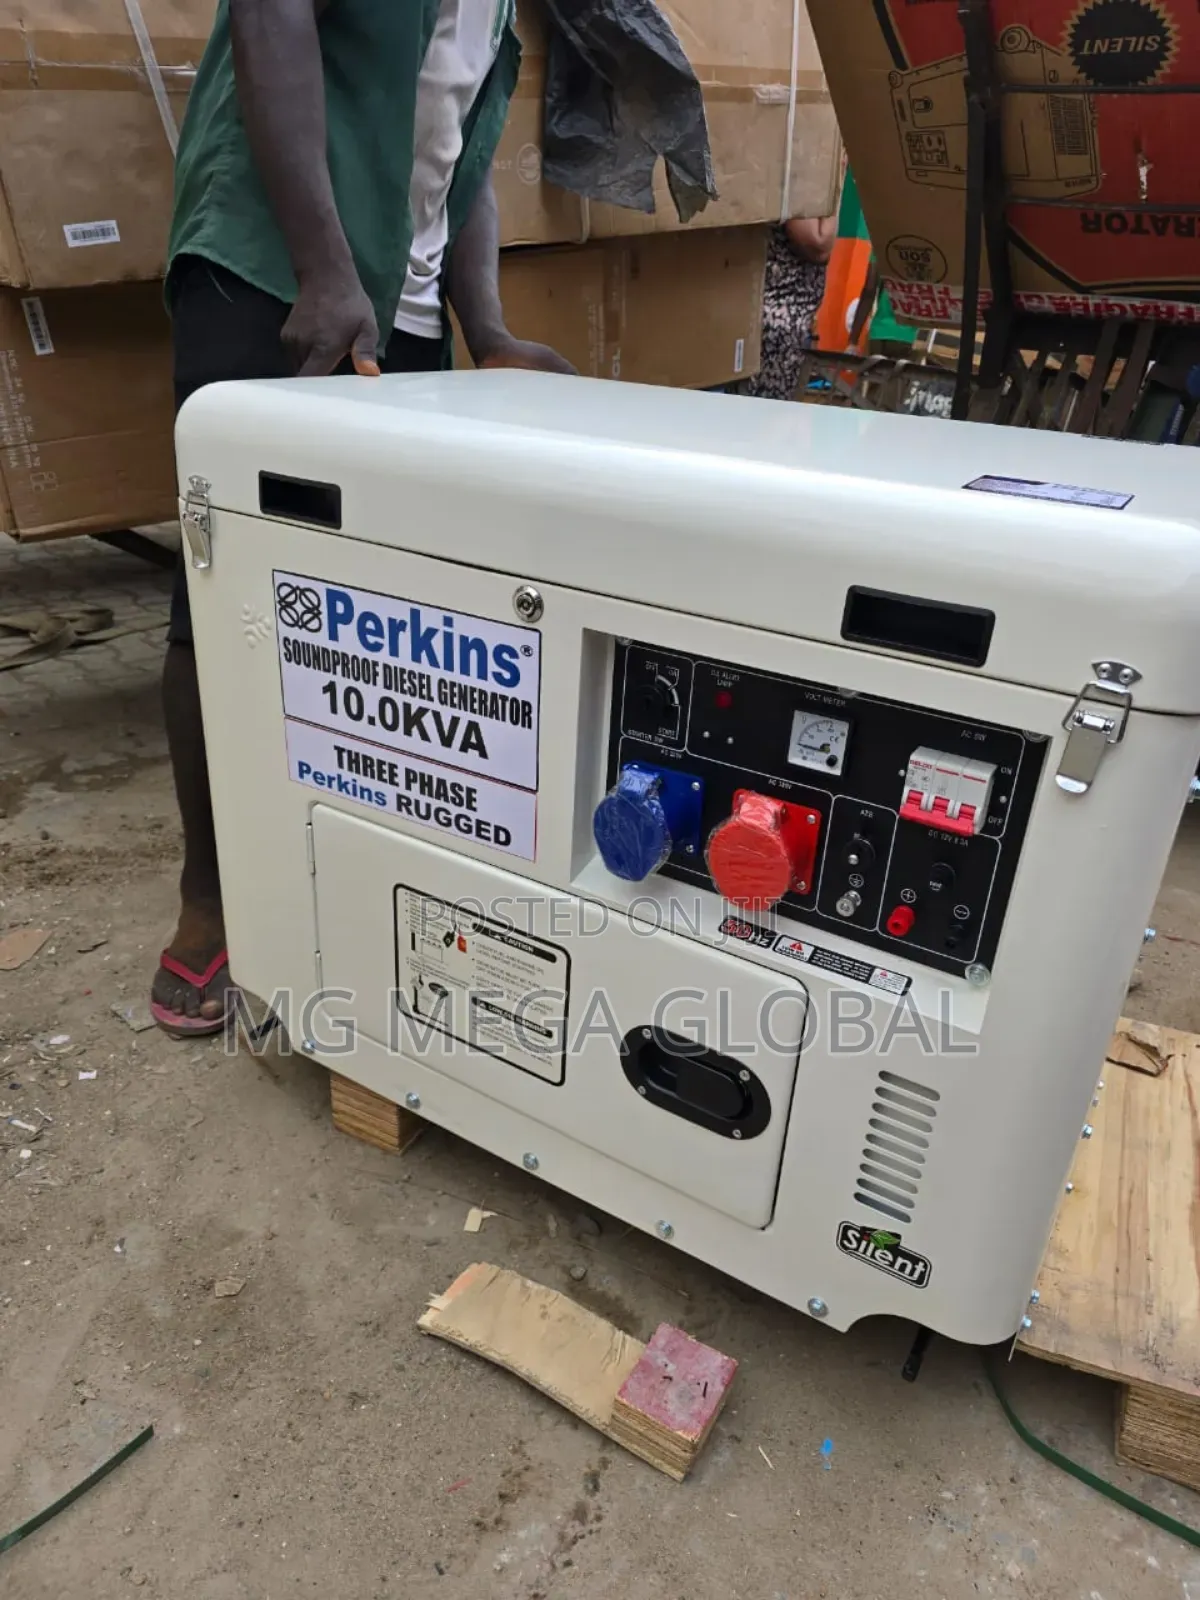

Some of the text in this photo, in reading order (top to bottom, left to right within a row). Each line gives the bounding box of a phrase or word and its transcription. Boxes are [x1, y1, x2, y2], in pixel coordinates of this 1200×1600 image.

[1079, 35, 1161, 55] SILENT
[1080, 212, 1200, 238] RATOR
[283, 636, 533, 730] SOUNDPROOF DIESEL GENERATOR
[804, 691, 846, 707] VOLT METER
[321, 680, 489, 760] 10.0KVA
[961, 729, 973, 739] AC
[334, 745, 477, 812] THREE PHASE
[1000, 767, 1012, 776] ON
[298, 760, 512, 848] Perkins RUGGED
[988, 816, 1004, 826] OFF
[842, 1229, 926, 1281] Silent
